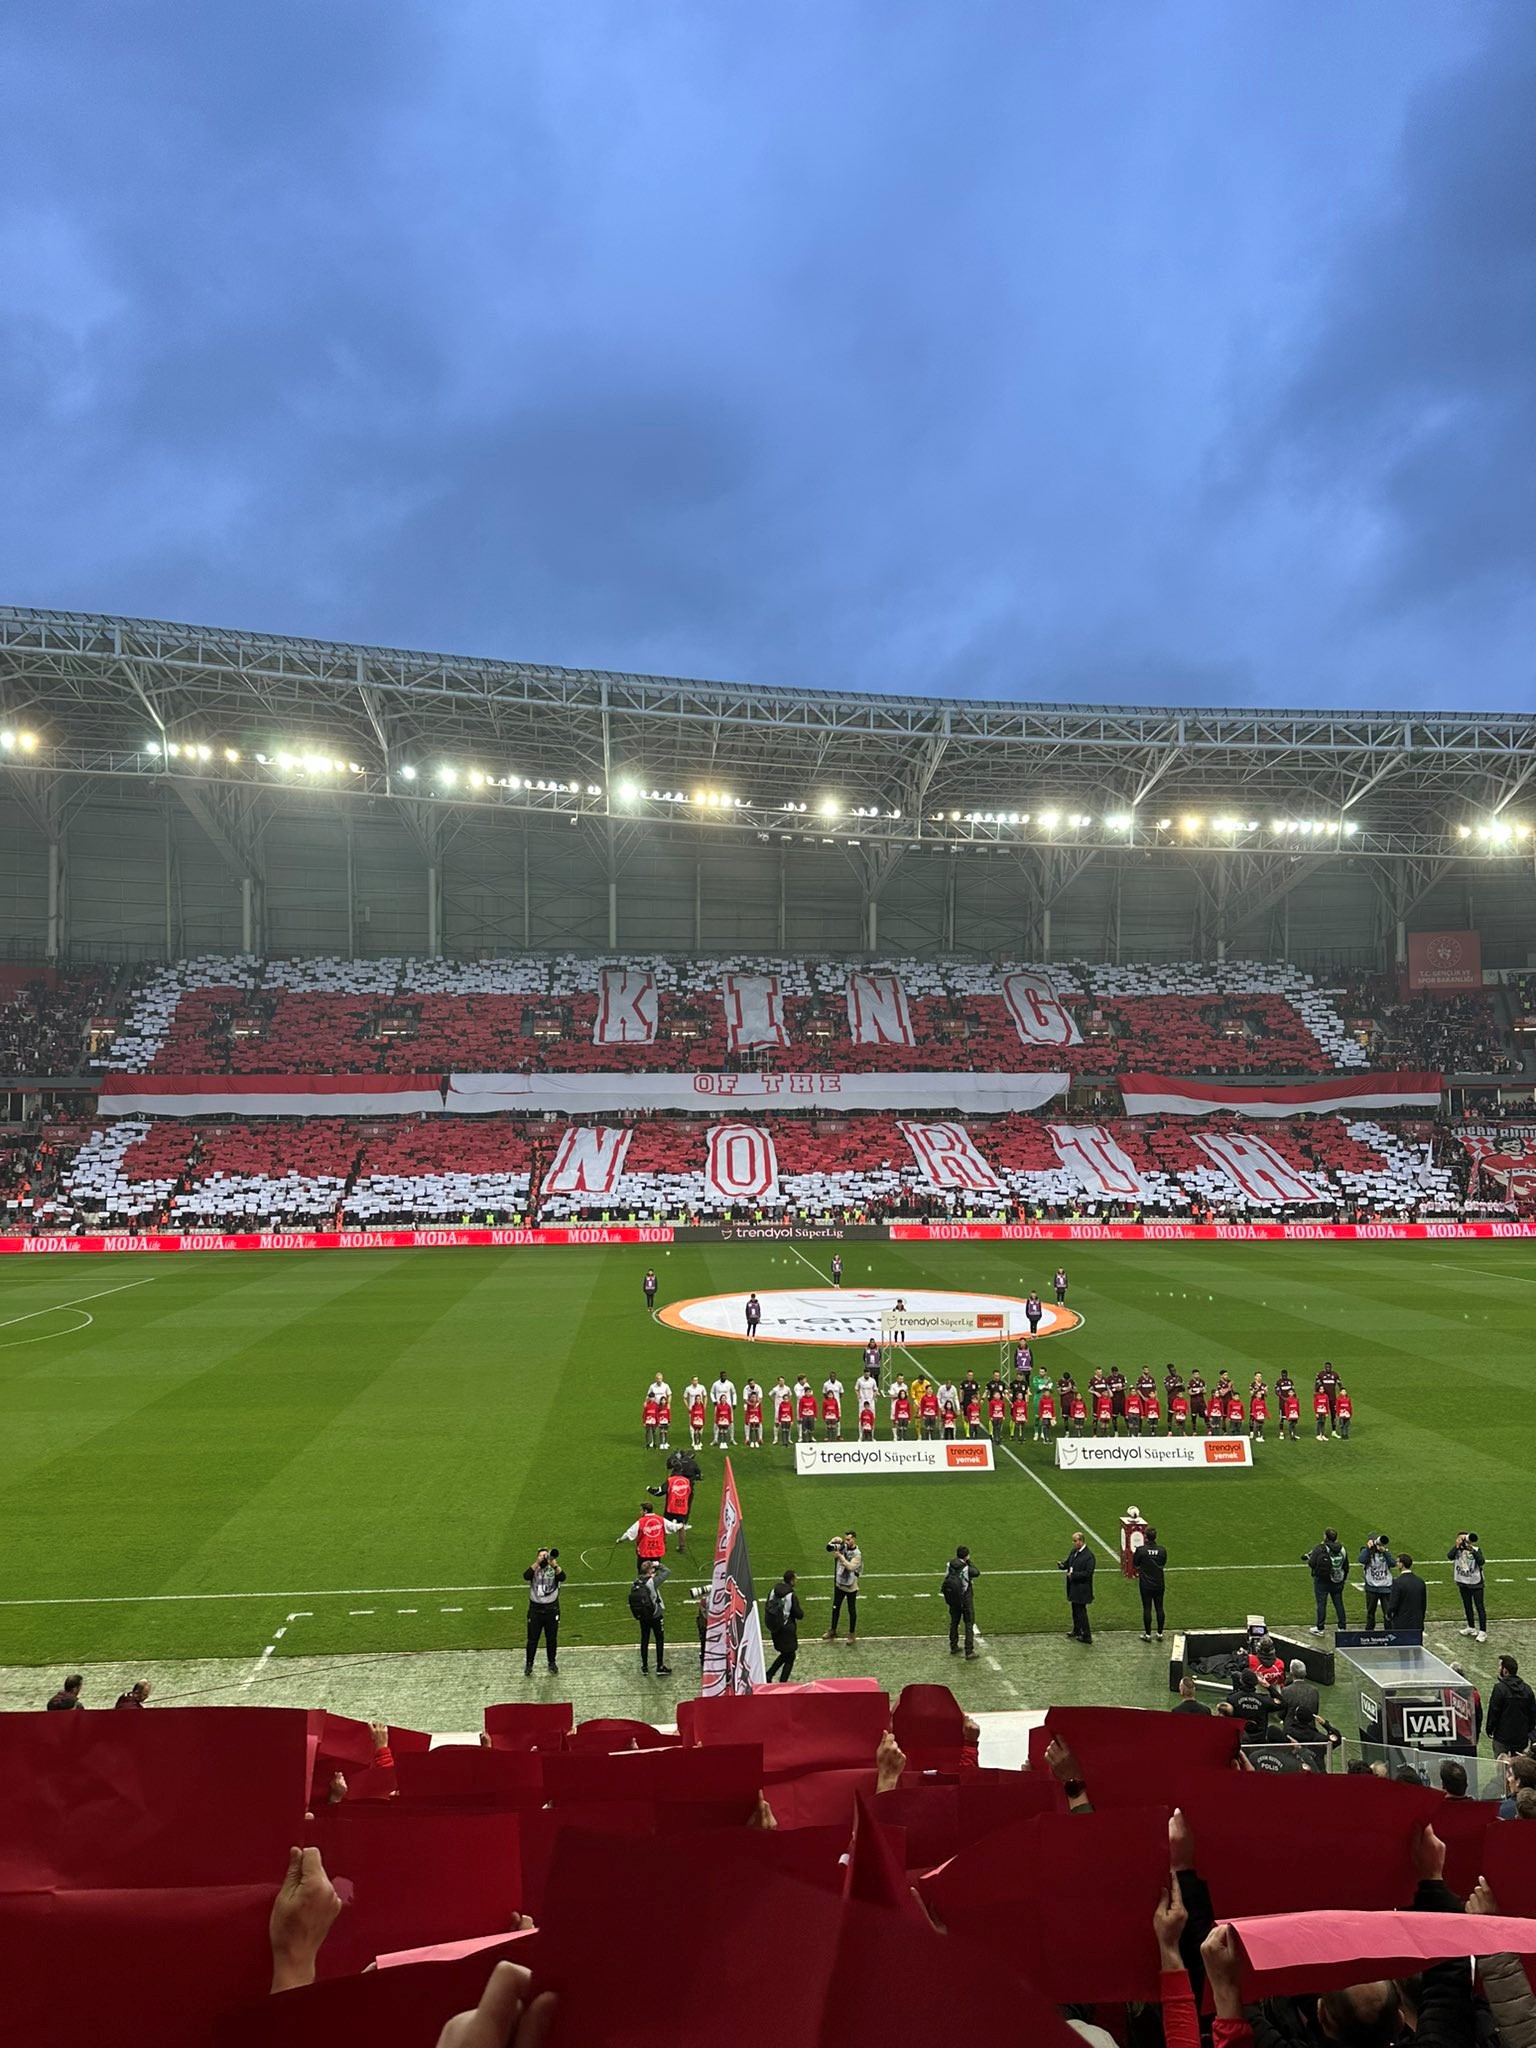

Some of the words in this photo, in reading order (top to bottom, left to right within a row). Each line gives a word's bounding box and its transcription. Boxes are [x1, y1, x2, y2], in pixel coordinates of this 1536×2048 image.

[694, 1074, 738, 1094] OF
[762, 1074, 842, 1093] THE
[549, 1121, 1320, 1201] NORTH
[568, 1229, 609, 1243] MODA
[639, 1228, 674, 1242] MOD
[736, 1227, 793, 1240] trendyol
[795, 1227, 844, 1239] SüperLig
[928, 1226, 970, 1239] MODA
[1001, 1226, 1043, 1239] MODA
[1070, 1226, 1112, 1239] MODA
[1143, 1226, 1183, 1239] MODA
[1216, 1226, 1256, 1239] MODA
[1284, 1226, 1324, 1238] MODA
[1355, 1225, 1395, 1238] MODA
[1426, 1225, 1465, 1238] MODA
[1491, 1224, 1531, 1237] MODA
[104, 1237, 147, 1250] MODA
[180, 1236, 223, 1249] MODA
[260, 1235, 303, 1248] MODA
[339, 1233, 383, 1247] MODA
[414, 1232, 456, 1245] MODA
[492, 1231, 534, 1244] MODA
[23, 1238, 67, 1252] MODA
[900, 1317, 939, 1327] trendyol
[940, 1318, 973, 1327] SüperLig
[950, 1448, 984, 1456] trendyol
[1082, 1446, 1141, 1461] trendyol
[1144, 1447, 1195, 1461] SüperLig
[1209, 1444, 1241, 1452] trendyol
[821, 1450, 881, 1465] trendyol
[884, 1451, 935, 1465] SüperLig
[955, 1456, 980, 1465] yemek
[1214, 1452, 1238, 1461] yemek
[1363, 1698, 1376, 1714] VAR
[1410, 1716, 1450, 1733] VAR
